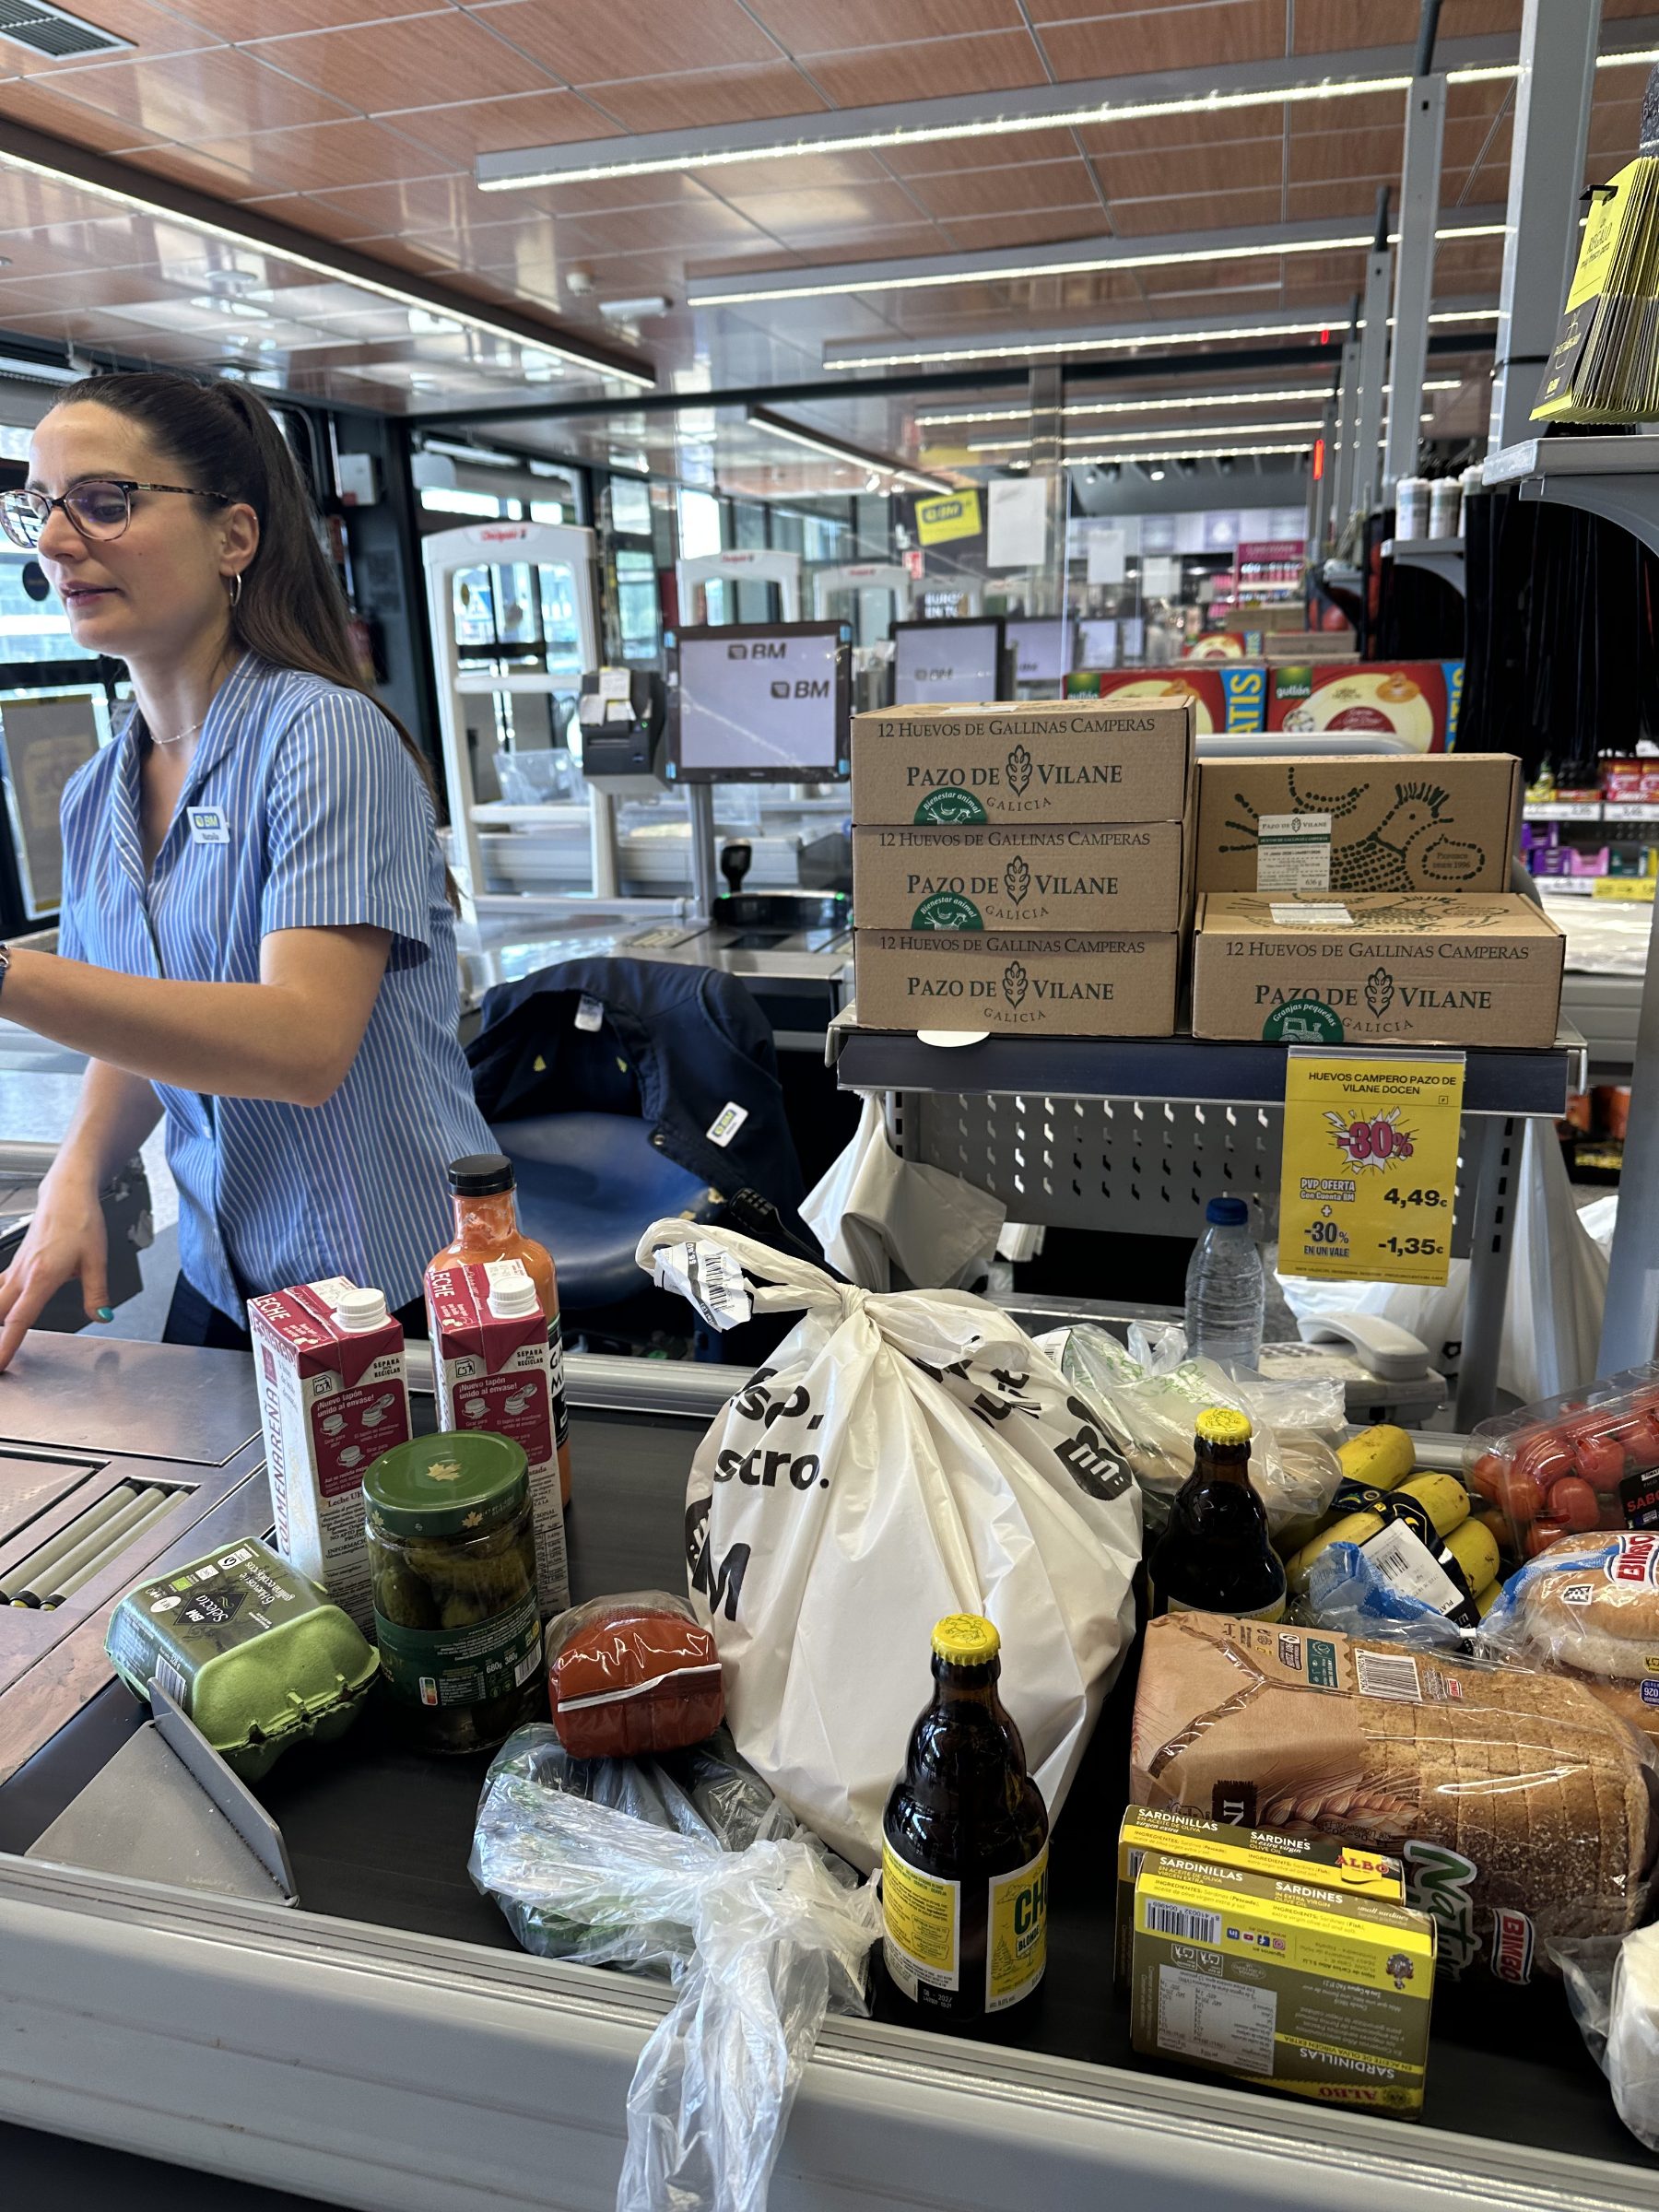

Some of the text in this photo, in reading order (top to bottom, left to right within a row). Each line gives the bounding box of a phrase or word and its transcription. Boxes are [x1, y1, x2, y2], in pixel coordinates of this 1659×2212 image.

[751, 642, 786, 660] BM
[794, 681, 830, 699] BM
[878, 718, 1155, 737] 12 HUEVOS DE GALLINAS CAMPERAS
[907, 764, 1123, 786] PAZO DE VILANE
[923, 791, 981, 815] Bienestar animal
[986, 796, 1052, 812] GALICIA
[879, 831, 1150, 847] 12 HUEVOS DE GALLINAS CAMPERAS
[907, 875, 1118, 895] PAZO DE VILANE
[921, 897, 977, 919] Bienestar animal
[985, 904, 1049, 920] GALICIA
[880, 936, 1145, 953] 12 HUEVOS DE GALLINAS CAMPERAS
[1226, 942, 1529, 959] 12 HUEVOS DE GALLINAS CAMPERAS
[907, 977, 1113, 1000] PAZO DE VILANE
[1254, 984, 1491, 1009] PAZO DE VILANE
[983, 1007, 1046, 1022] GALICIA
[1273, 1003, 1336, 1027] Granjas pequeñas
[1342, 1017, 1413, 1033] GALICIA
[1309, 1073, 1456, 1085] HUEVOS CAMPERO PAZO DE
[1343, 1084, 1420, 1094] VILANE DOCEN
[1336, 1122, 1414, 1159] -30%
[1300, 1178, 1356, 1192] PVP OFERTA
[1300, 1191, 1315, 1200] Con
[1316, 1192, 1341, 1201] Cuenta
[1383, 1188, 1448, 1208] 4,49€
[1304, 1246, 1349, 1257] EN UN VALE
[1378, 1237, 1444, 1257] -1,35€
[253, 1294, 291, 1322] LECHE
[517, 1349, 543, 1358] SEPARA
[373, 1359, 400, 1369] SEPARA
[518, 1358, 544, 1366] RECICLAR
[374, 1368, 400, 1378] RECICLAR
[459, 1377, 506, 1393] ¡Nuevo tapón
[459, 1391, 480, 1399] unido
[489, 1382, 517, 1393] envase!
[317, 1389, 362, 1411] ¡Nuevo tapón
[318, 1406, 337, 1418] unido
[347, 1394, 374, 1407] envase!
[328, 1490, 364, 1508] Leche UH
[244, 1561, 296, 1602] gallina ecológicos
[246, 1579, 267, 1600] Huevos
[186, 1609, 205, 1622] BM
[195, 1594, 228, 1622] Selecta
[1136, 1820, 1179, 1834] virgen extra
[1138, 1808, 1218, 1831] SARDINILLAS
[1146, 1817, 1171, 1828] ACEITE
[1182, 1824, 1201, 1833] OLIVA
[1135, 1830, 1180, 1844] INGREDIENTES:
[1251, 1831, 1311, 1851] SARDINES
[1250, 1842, 1269, 1853] OLIVE
[1258, 1841, 1278, 1849] extra
[1279, 1844, 1301, 1853] virgin
[1248, 1853, 1291, 1865] INGREDIENTS:
[1335, 1854, 1389, 1875] ALBO
[1159, 1856, 1243, 1882] SARDINILLAS
[1167, 1867, 1191, 1877] ACEITE
[1203, 1875, 1223, 1884] OLIVA
[1158, 1870, 1204, 1885] VIRGEN EXTRA
[1155, 1879, 1203, 1894] INGREDIENTES:
[1276, 1882, 1343, 1903] SARDINES
[1275, 1896, 1294, 1905] OLIVE
[1284, 1893, 1305, 1901] EXTRA
[1307, 1899, 1331, 1908] VIRGIN
[1273, 1905, 1318, 1919] INGREDIENTS:
[1018, 1925, 1040, 1952] BLONDE
[1501, 1915, 1524, 1981] BIMBO
[1284, 2035, 1309, 2046] EXTRA
[1310, 2041, 1336, 2053] VIRGEN
[1338, 2049, 1361, 2059] OLIVA
[1300, 2048, 1394, 2078] SARDINILLAS
[1373, 2058, 1401, 2069] ACEITE
[1320, 2087, 1377, 2100] ALBO
